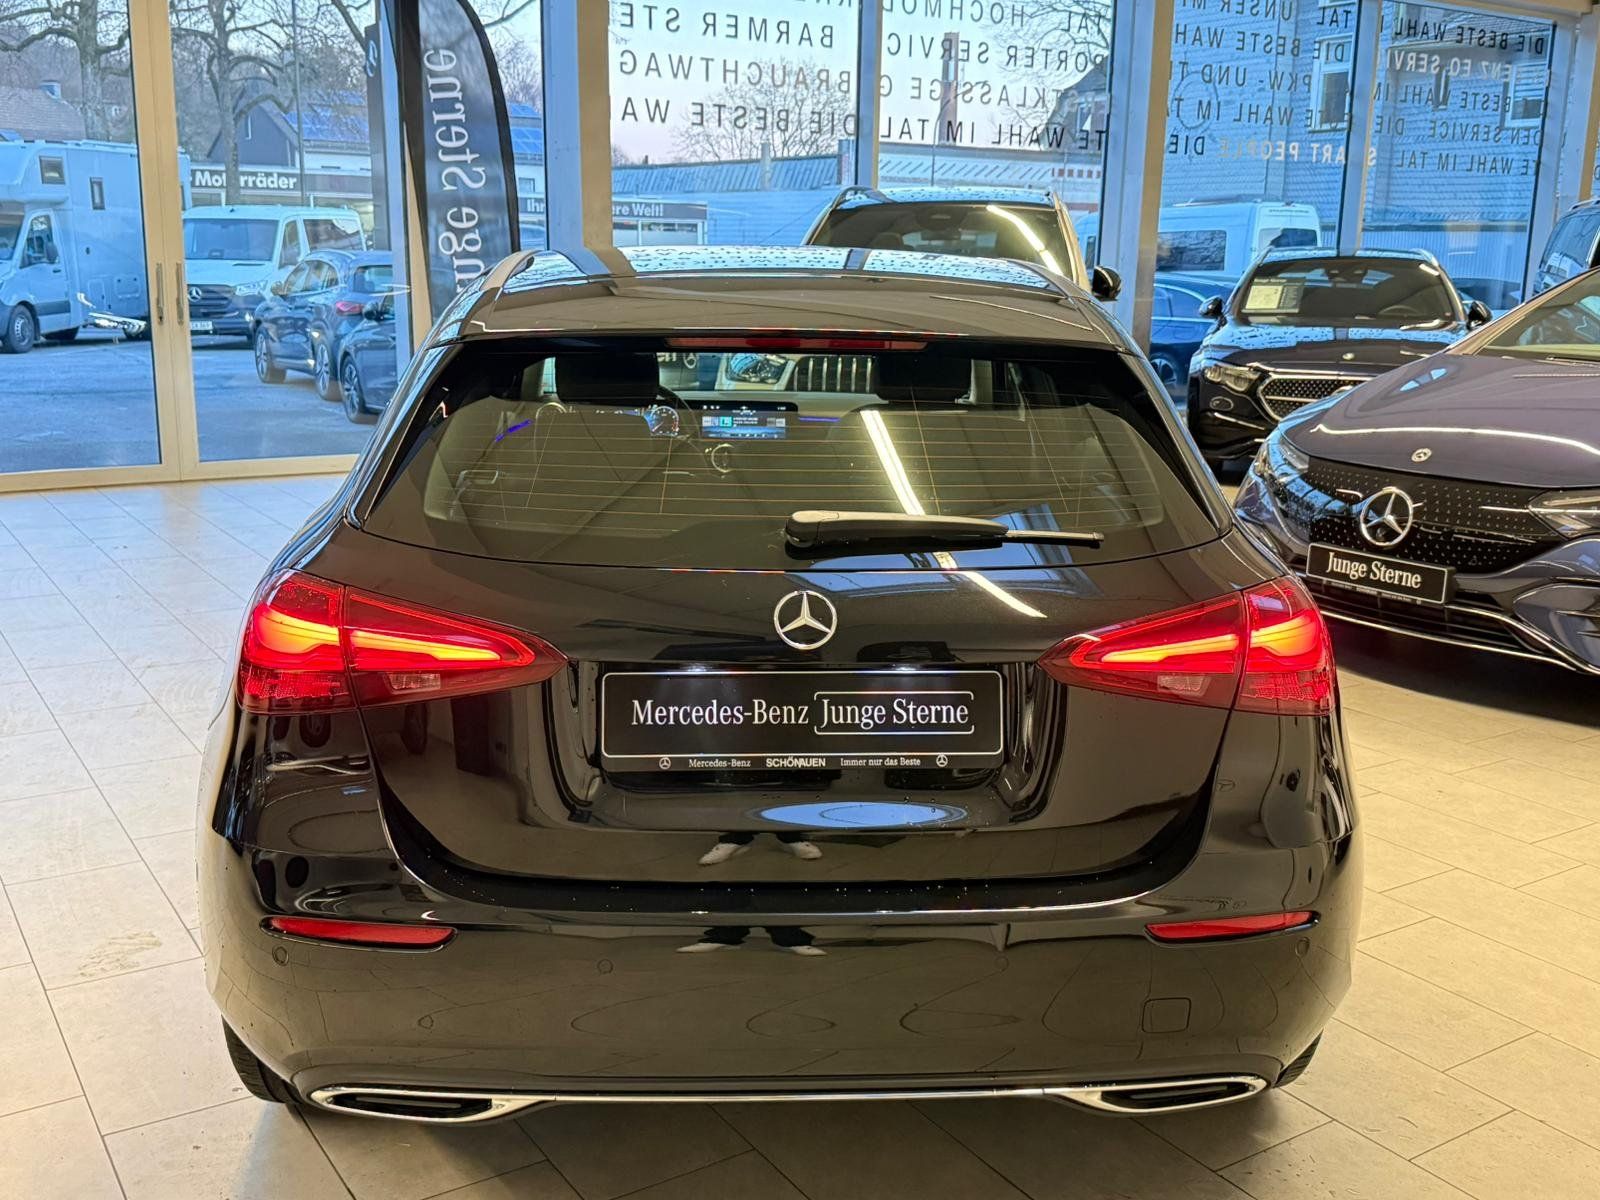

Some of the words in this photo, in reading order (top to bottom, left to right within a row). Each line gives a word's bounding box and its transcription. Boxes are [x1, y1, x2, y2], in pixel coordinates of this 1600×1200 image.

[194, 170, 298, 190] Motrräder
[1326, 551, 1368, 580] Junge
[1369, 560, 1422, 589] Sterne
[631, 698, 809, 726] Mercedes-Benz
[820, 699, 887, 730] Junge
[892, 698, 970, 725] Sterne
[688, 758, 752, 769] Mercedes-Benz
[840, 757, 867, 768] Immer
[868, 758, 883, 767] nur
[884, 756, 899, 767] das
[899, 756, 922, 767] Beste
